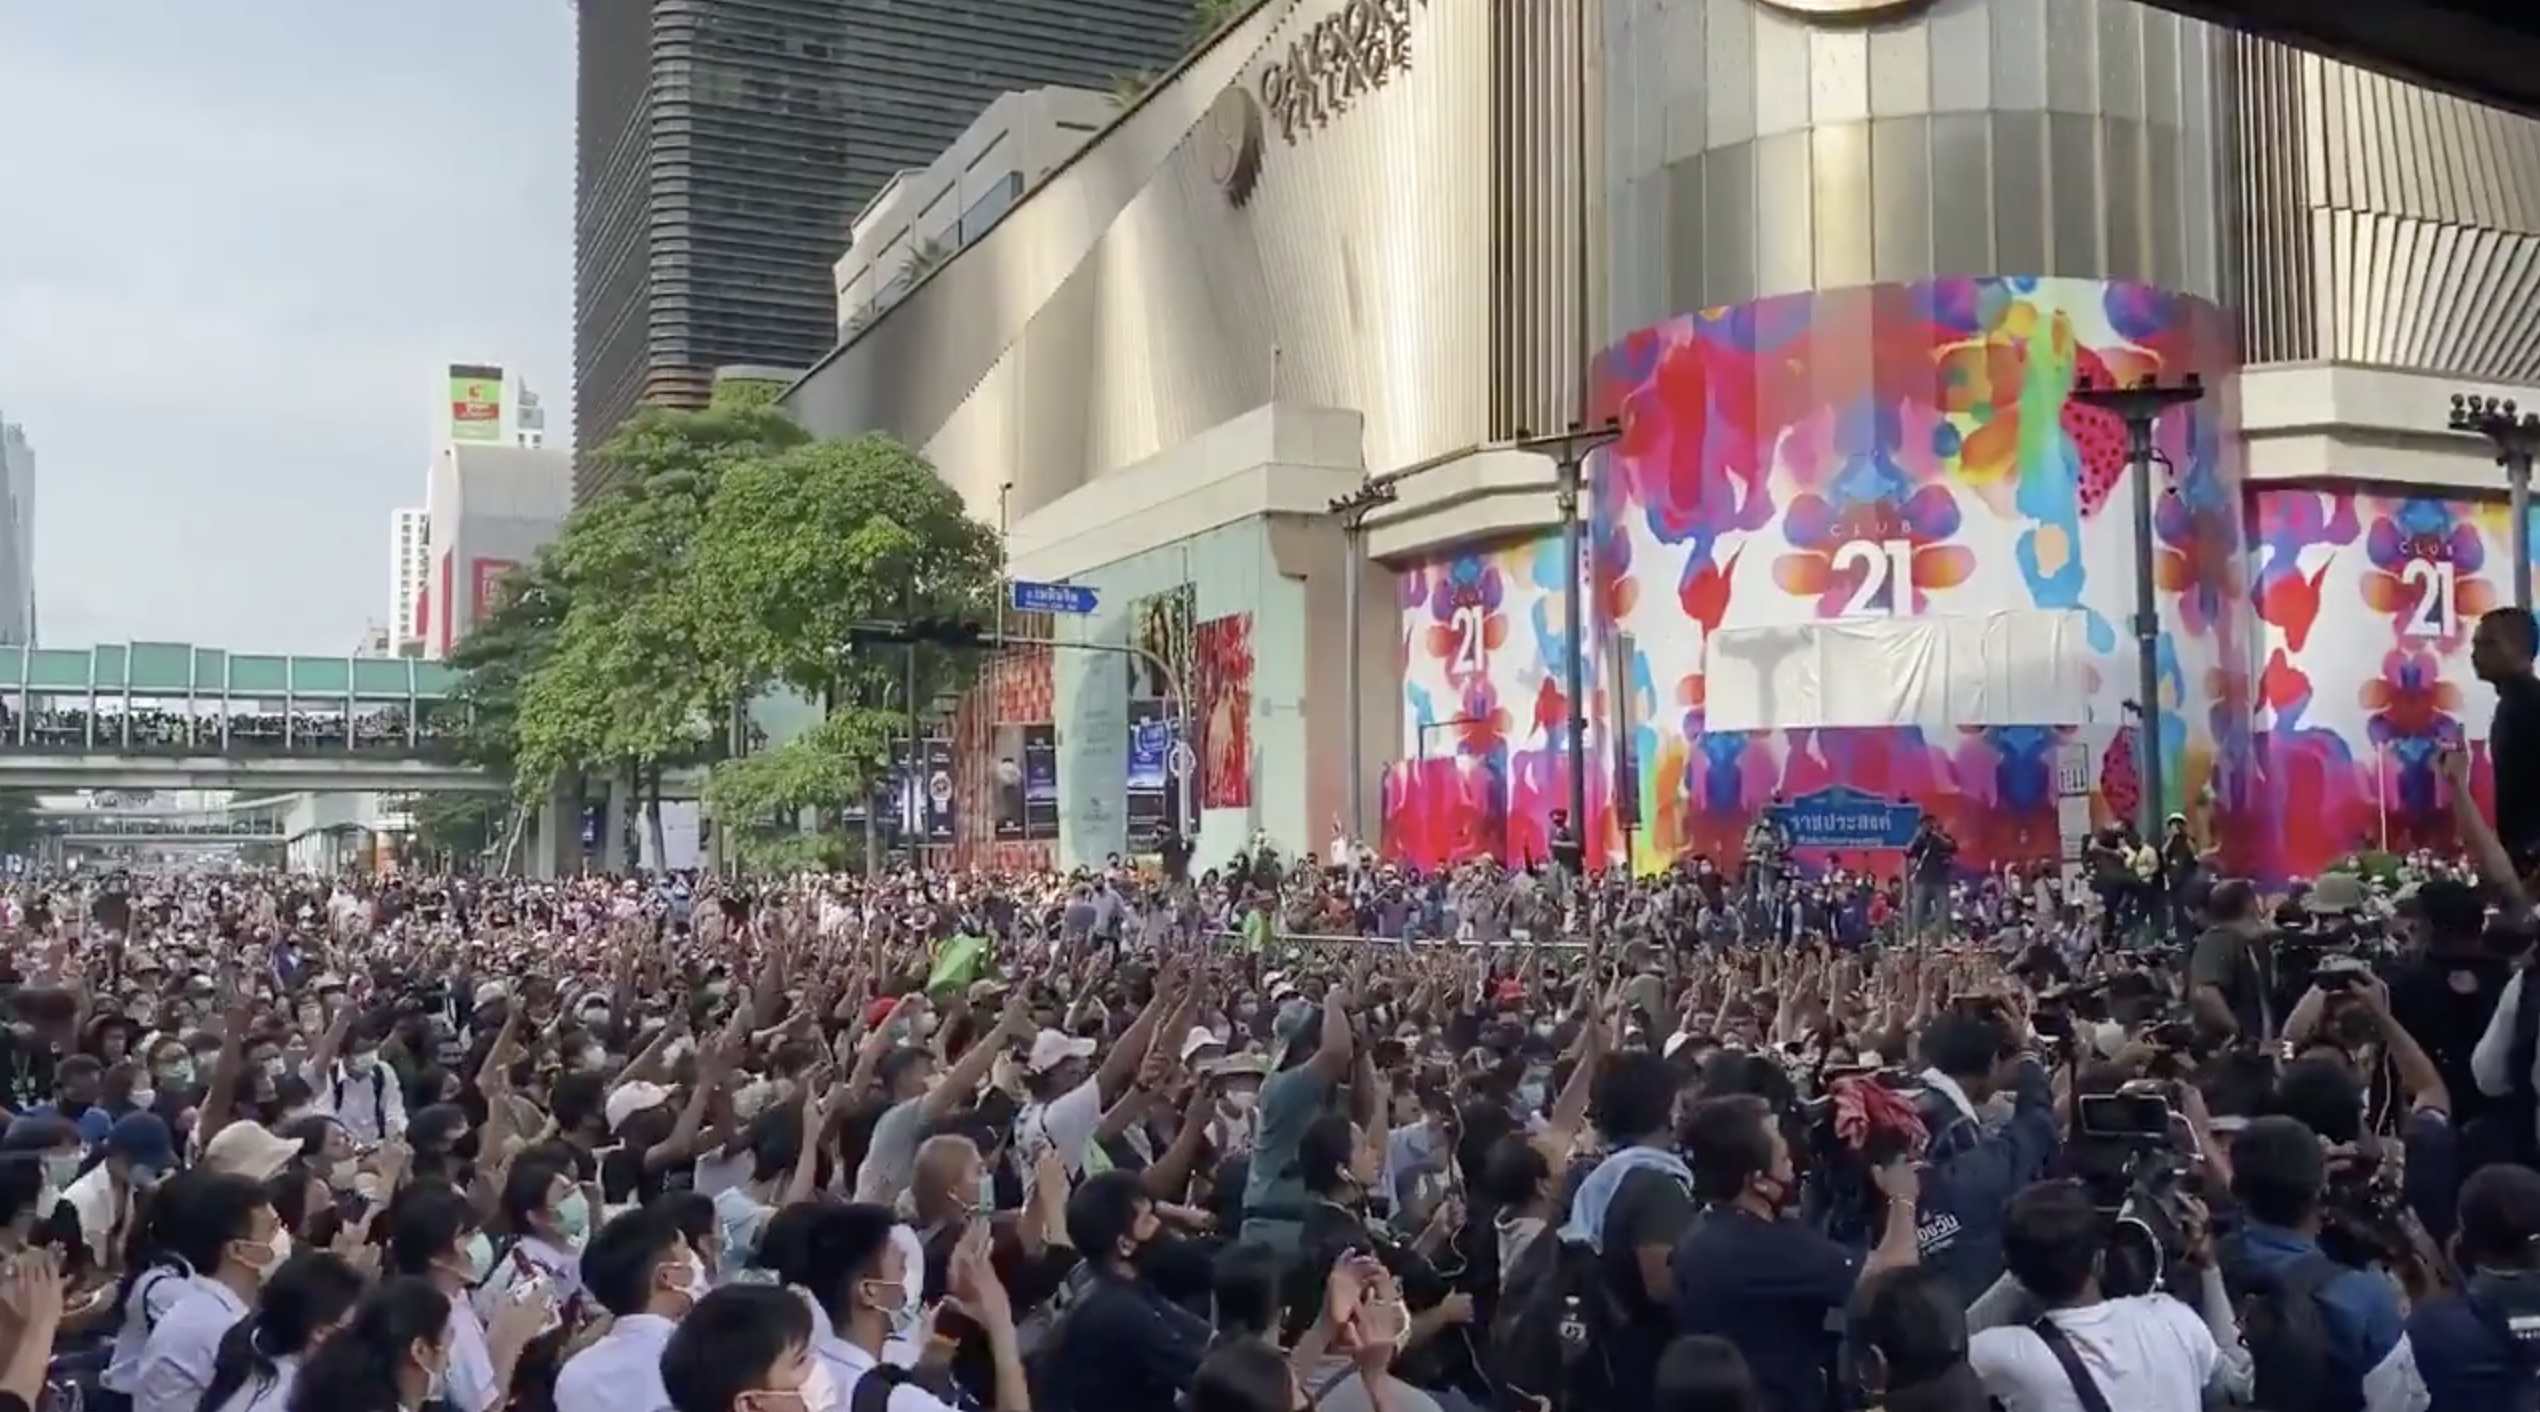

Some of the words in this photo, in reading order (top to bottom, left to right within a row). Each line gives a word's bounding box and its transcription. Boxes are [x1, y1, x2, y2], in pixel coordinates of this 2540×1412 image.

[1829, 519, 1912, 538] CLUB
[1831, 539, 1912, 617] 21
[2402, 557, 2455, 637] 21
[1450, 605, 1484, 674] 21
